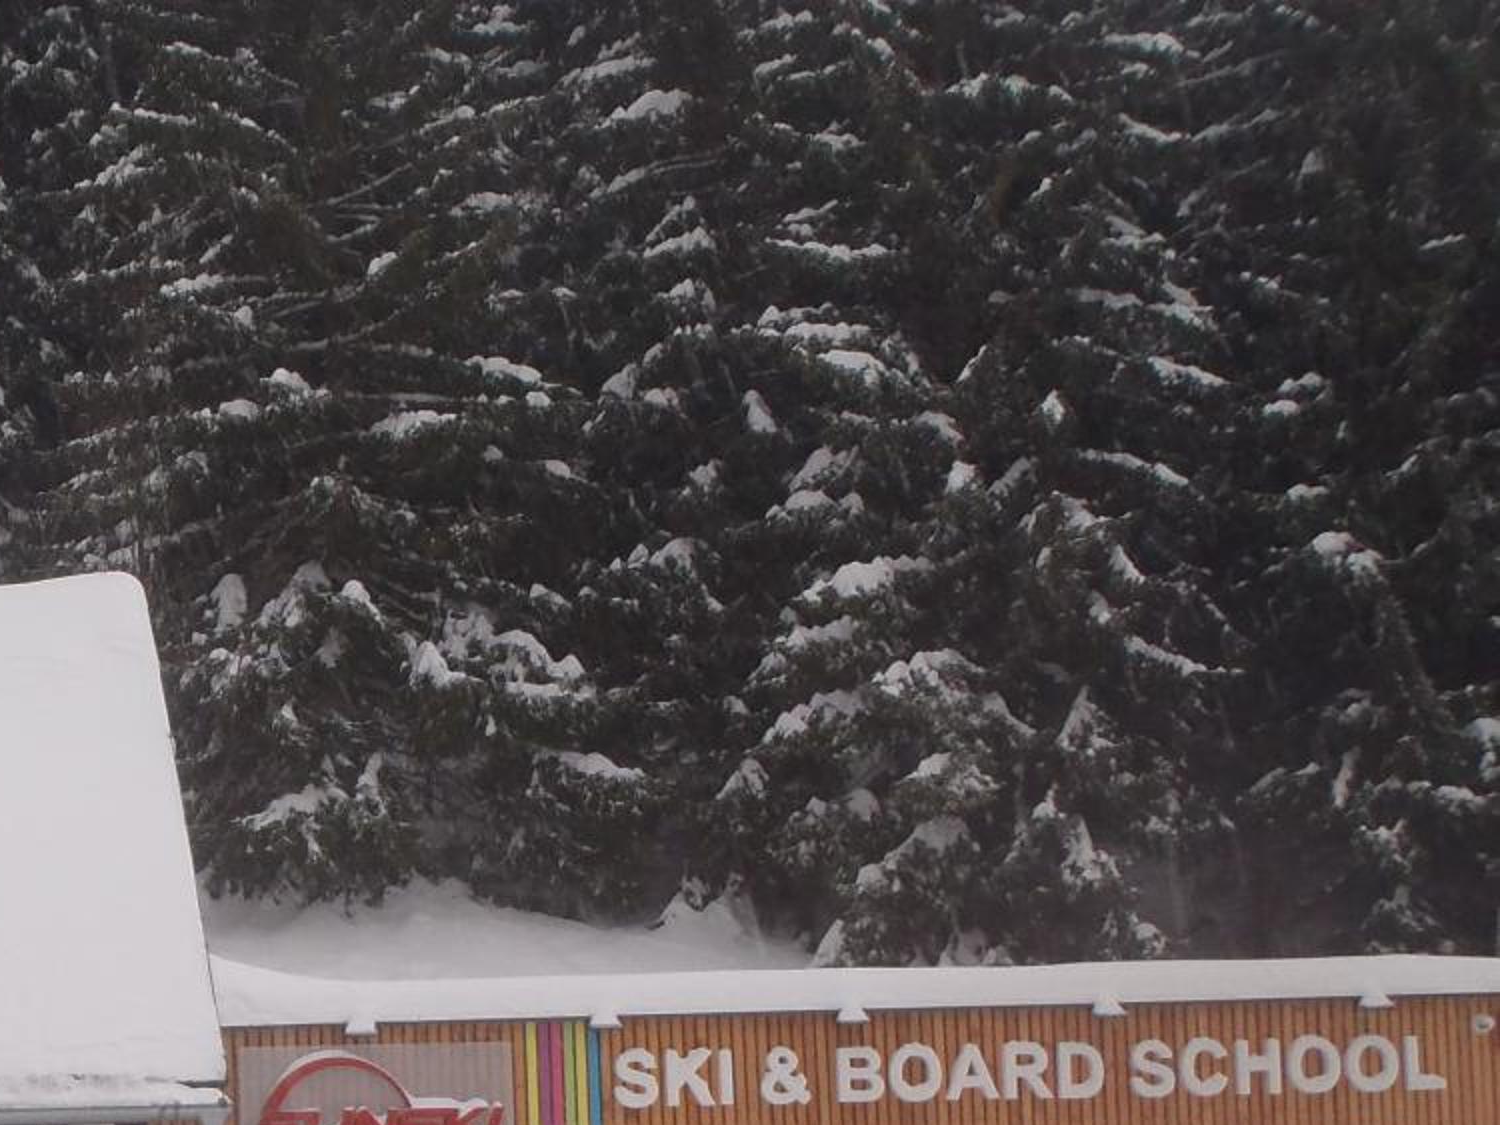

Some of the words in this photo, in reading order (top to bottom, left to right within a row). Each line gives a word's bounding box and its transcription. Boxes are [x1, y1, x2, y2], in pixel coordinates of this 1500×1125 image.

[614, 1047, 735, 1109] SKI
[761, 1046, 811, 1105] &
[836, 1041, 1105, 1102] BOARD
[1129, 1034, 1447, 1098] SCHOOL
